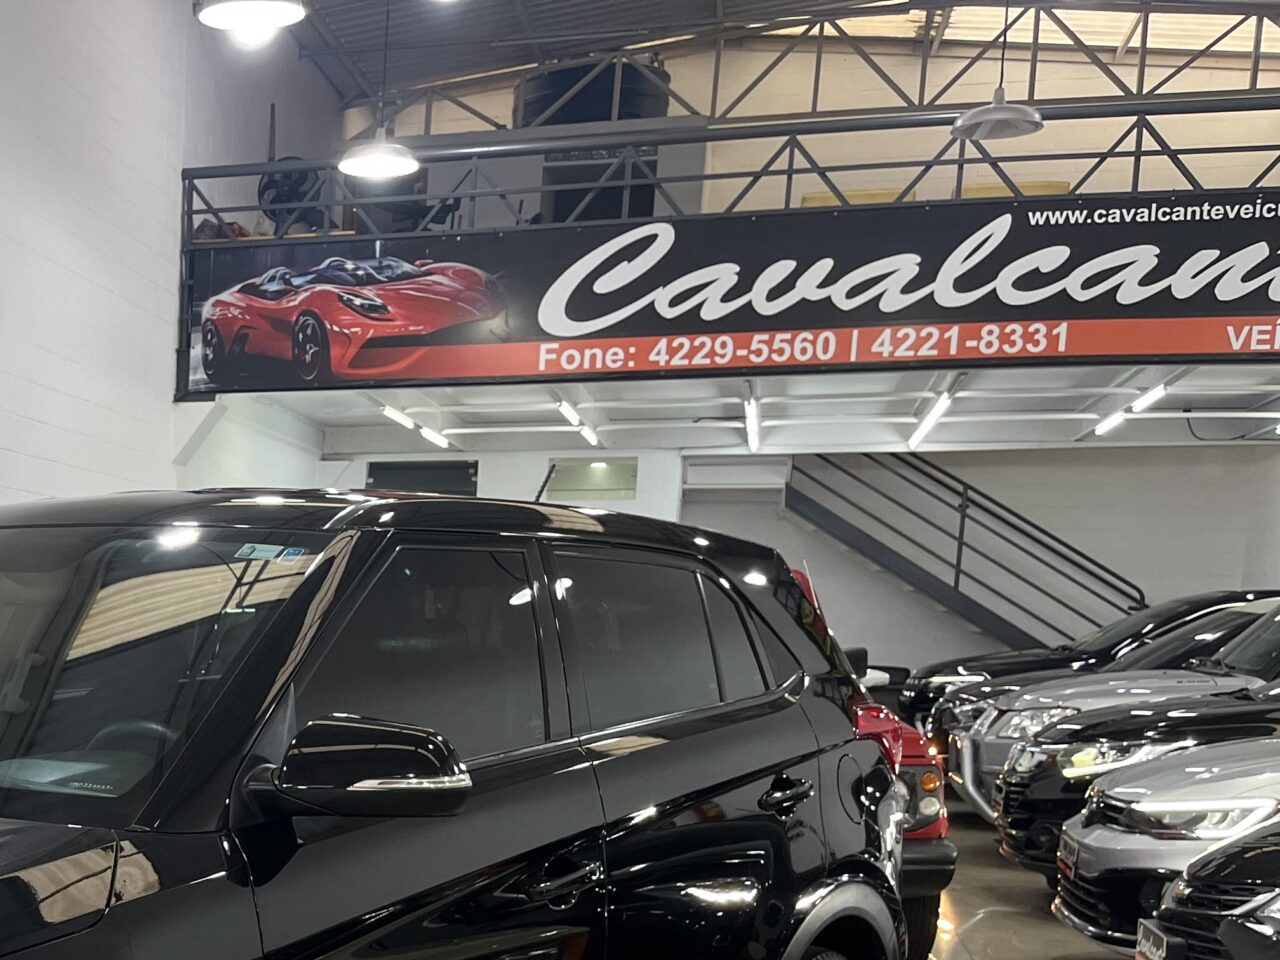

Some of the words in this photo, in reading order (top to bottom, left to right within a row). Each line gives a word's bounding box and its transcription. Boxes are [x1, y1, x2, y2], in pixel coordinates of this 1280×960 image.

[1028, 198, 1280, 226] www.cavalcanteveic
[537, 213, 1280, 338] Cavalcan
[538, 343, 636, 371] Fone:
[648, 330, 836, 366] 4229-5560
[871, 322, 1068, 357] 4221-8331
[1227, 318, 1280, 351] VEÍ
